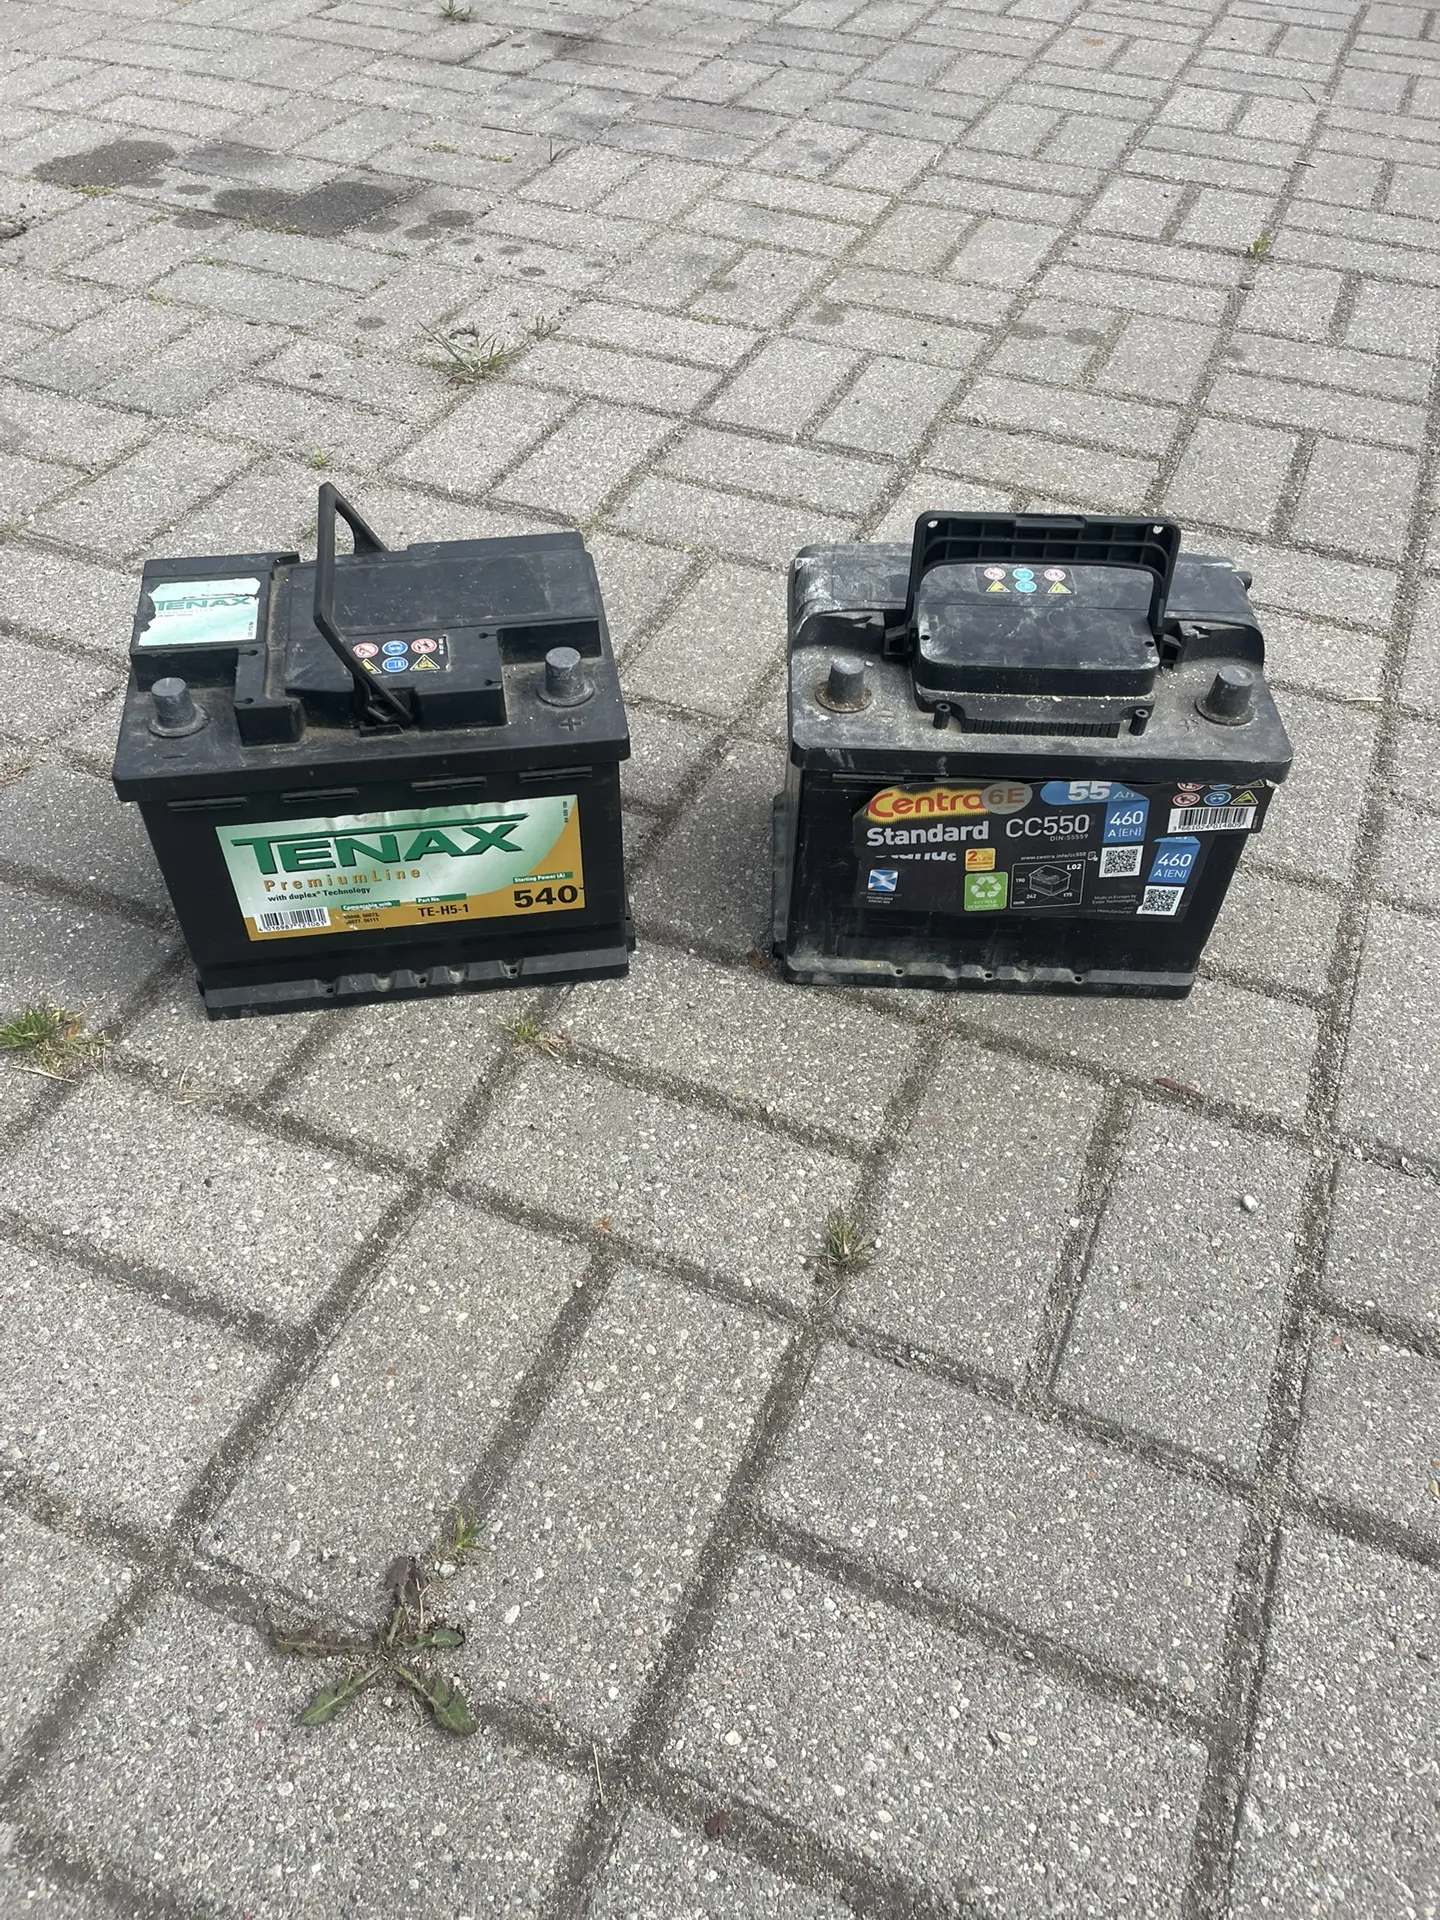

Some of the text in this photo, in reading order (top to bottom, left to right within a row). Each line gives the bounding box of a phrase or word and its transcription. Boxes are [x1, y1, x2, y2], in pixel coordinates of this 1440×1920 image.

[155, 595, 251, 611] TENAX
[1068, 781, 1112, 801] 55
[869, 787, 1026, 819] Centra 6E
[1110, 810, 1145, 826] 460
[866, 814, 1091, 846] Standard CC550
[1108, 829, 1117, 838] A
[230, 813, 530, 876] TENAX
[968, 850, 978, 862] 2
[1157, 853, 1193, 868] 460
[514, 872, 566, 884] Starting Power (A)
[1153, 869, 1163, 878] A
[268, 894, 288, 902] with
[322, 887, 371, 897] Technology
[417, 895, 441, 904] Part No.
[513, 884, 578, 909] 540
[418, 903, 470, 918] TE-H5-1
